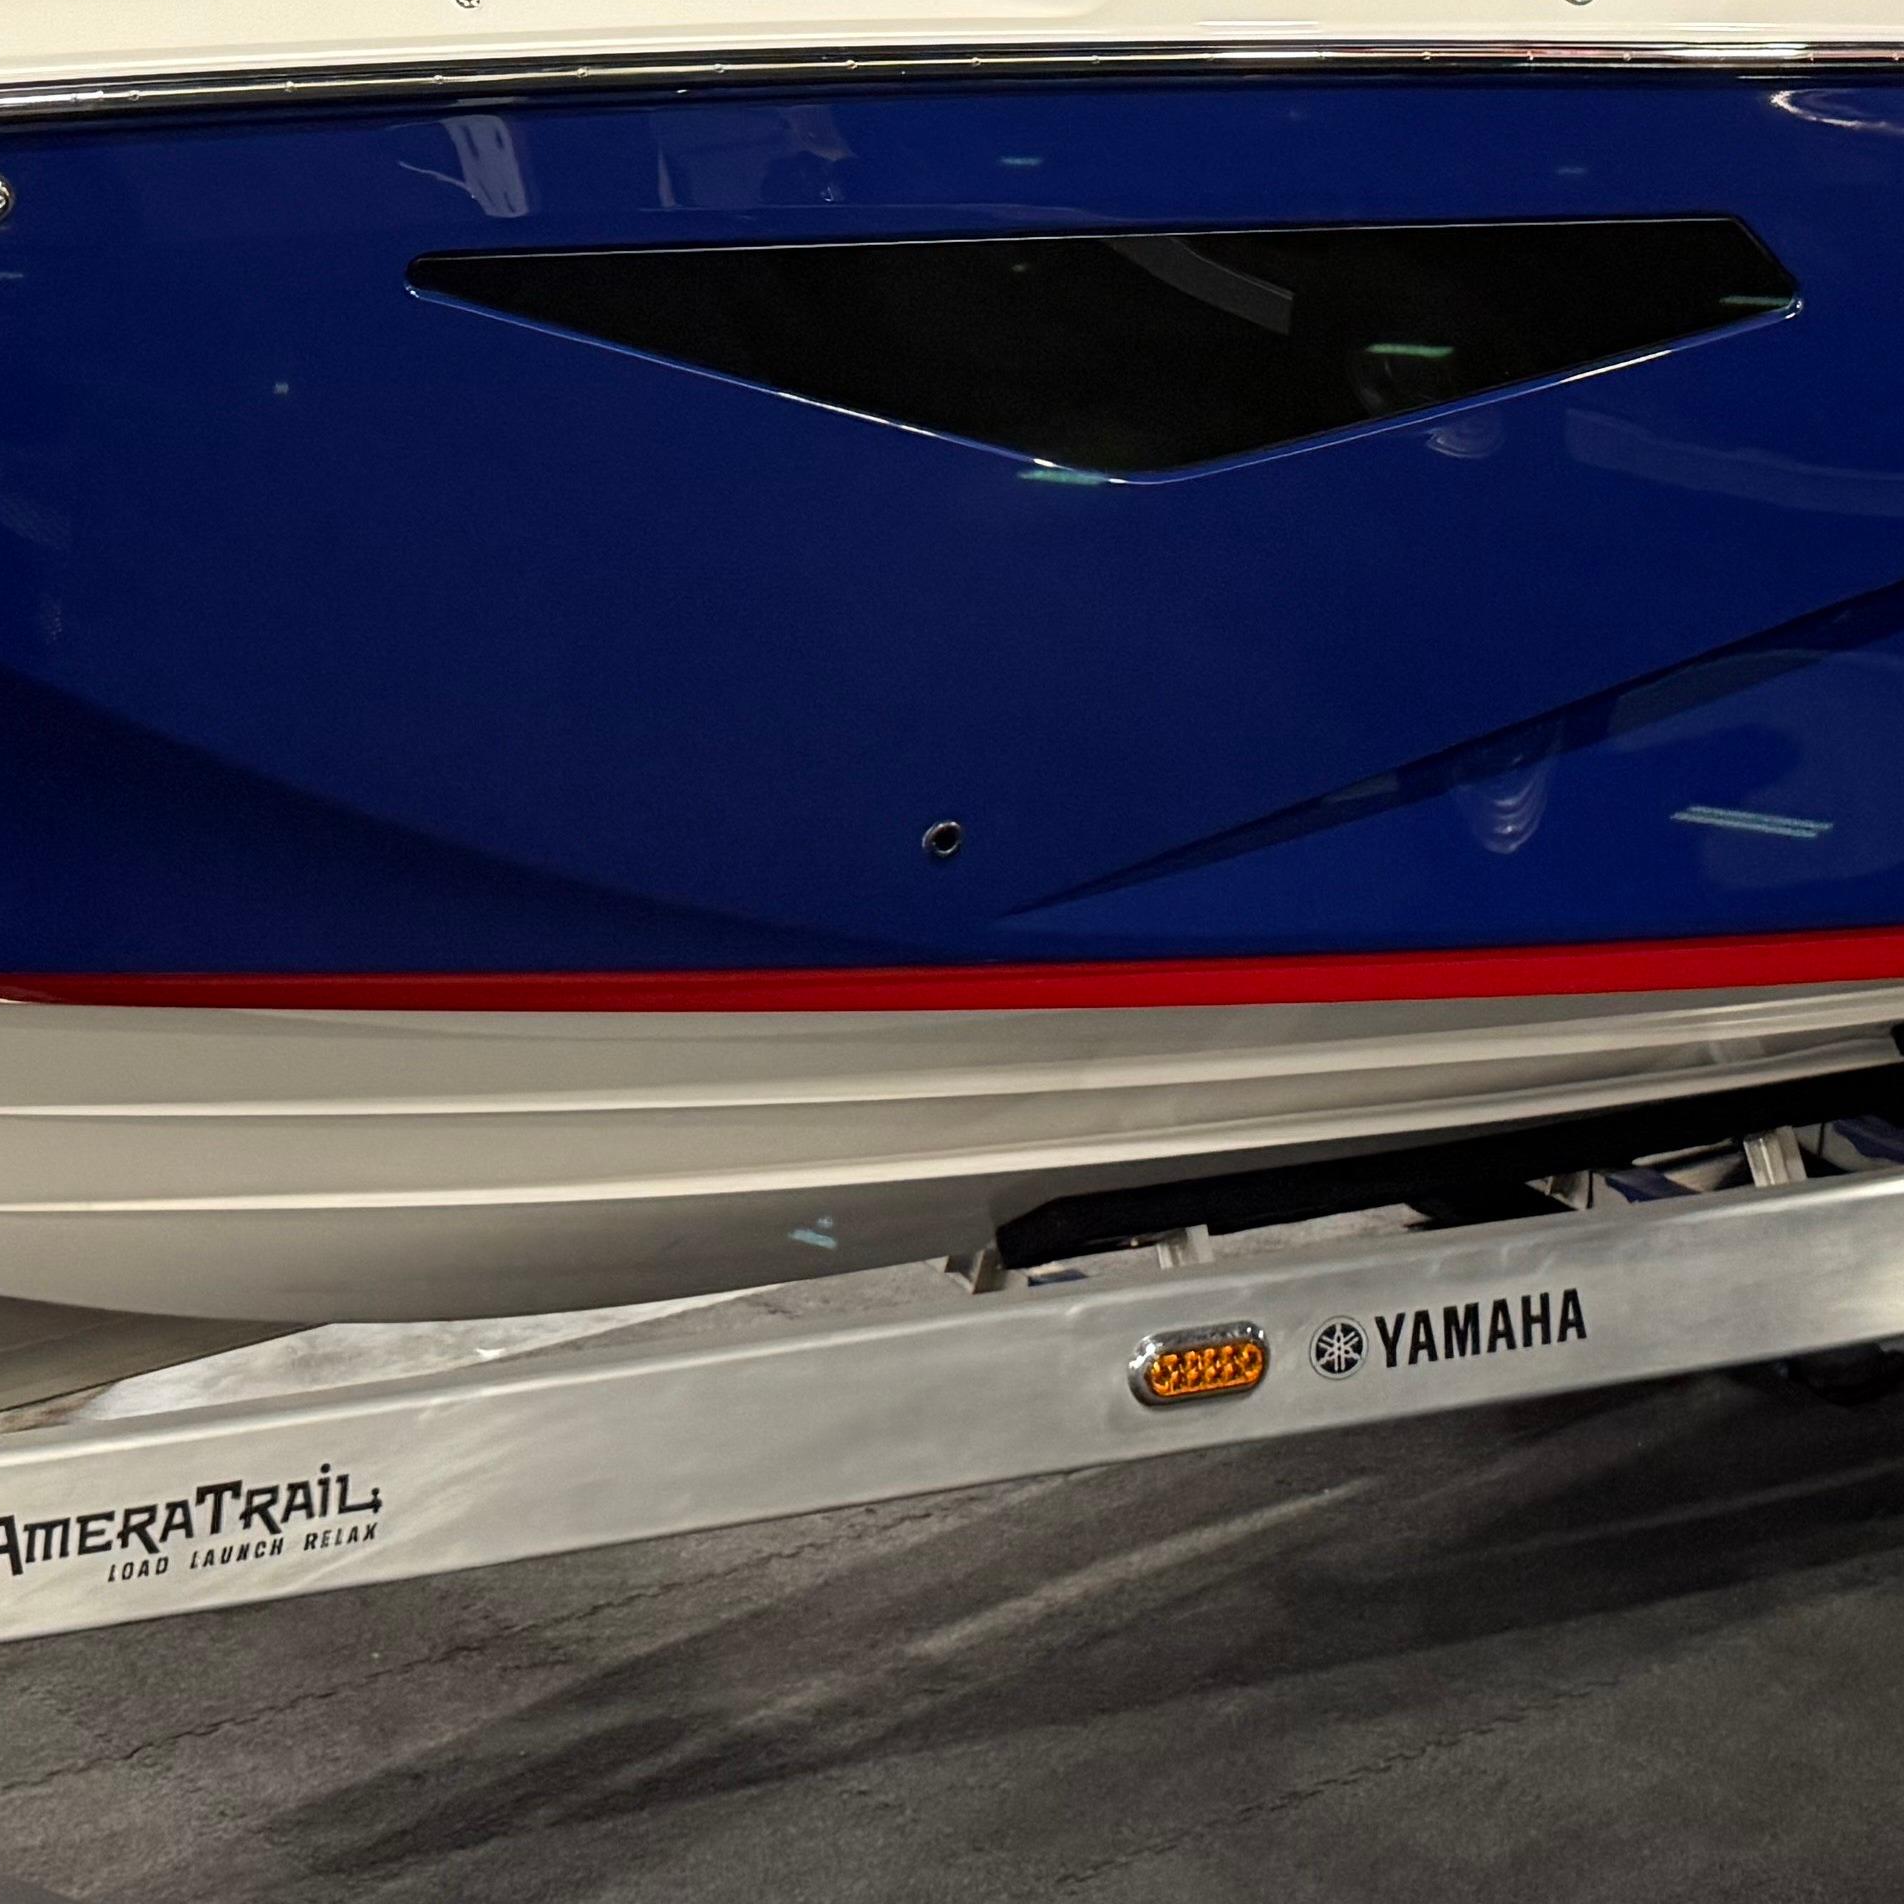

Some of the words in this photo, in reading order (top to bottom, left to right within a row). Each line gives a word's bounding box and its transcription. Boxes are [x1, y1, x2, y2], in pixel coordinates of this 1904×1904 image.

[1375, 1288, 1588, 1369] YAMAHA
[107, 1556, 170, 1583] LOAD
[189, 1540, 284, 1570] LAUNCH
[303, 1522, 379, 1552] RELAX
